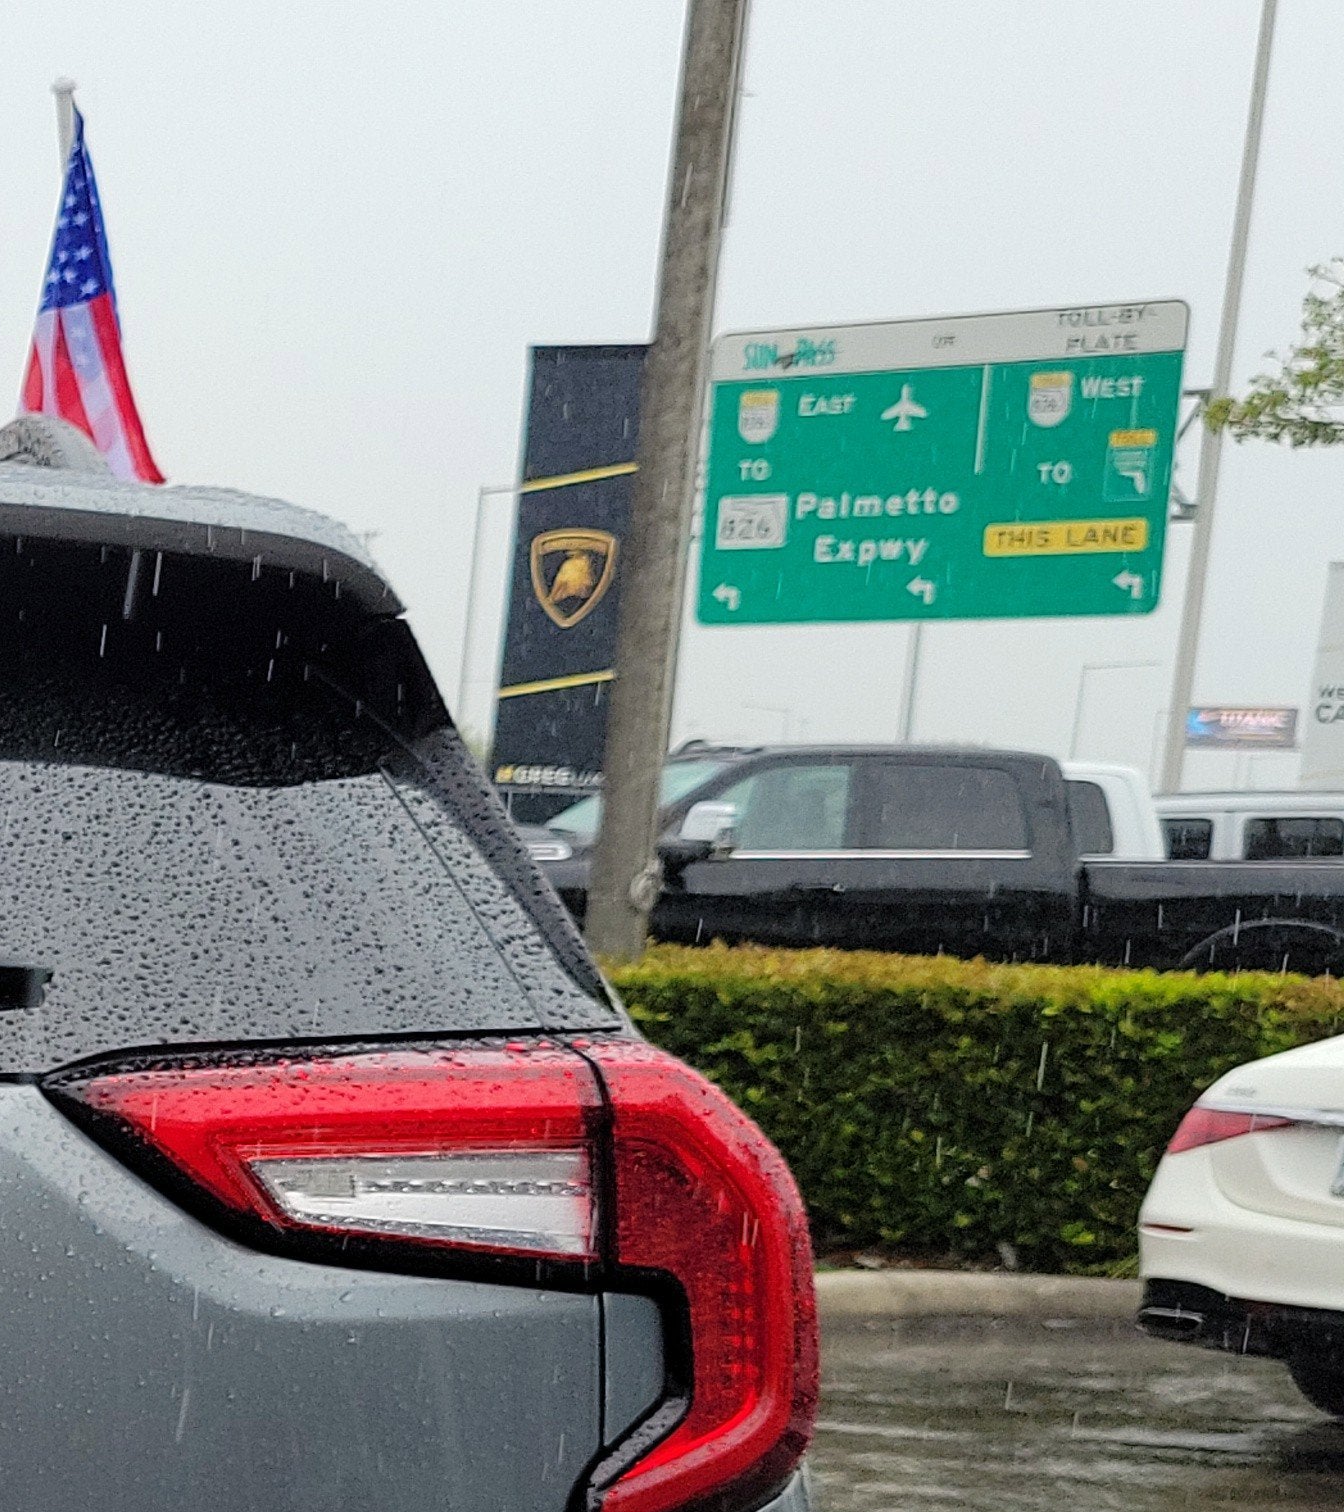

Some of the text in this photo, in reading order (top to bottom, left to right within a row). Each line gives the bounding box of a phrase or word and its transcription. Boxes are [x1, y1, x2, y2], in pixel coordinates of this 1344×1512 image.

[1080, 375, 1146, 399] WEST
[797, 392, 858, 417] EAST
[738, 458, 773, 481] TO
[1036, 460, 1073, 485] TO
[794, 487, 961, 520] Palmetto
[996, 523, 1138, 549] THIS LANE
[813, 534, 930, 567] Expwy
